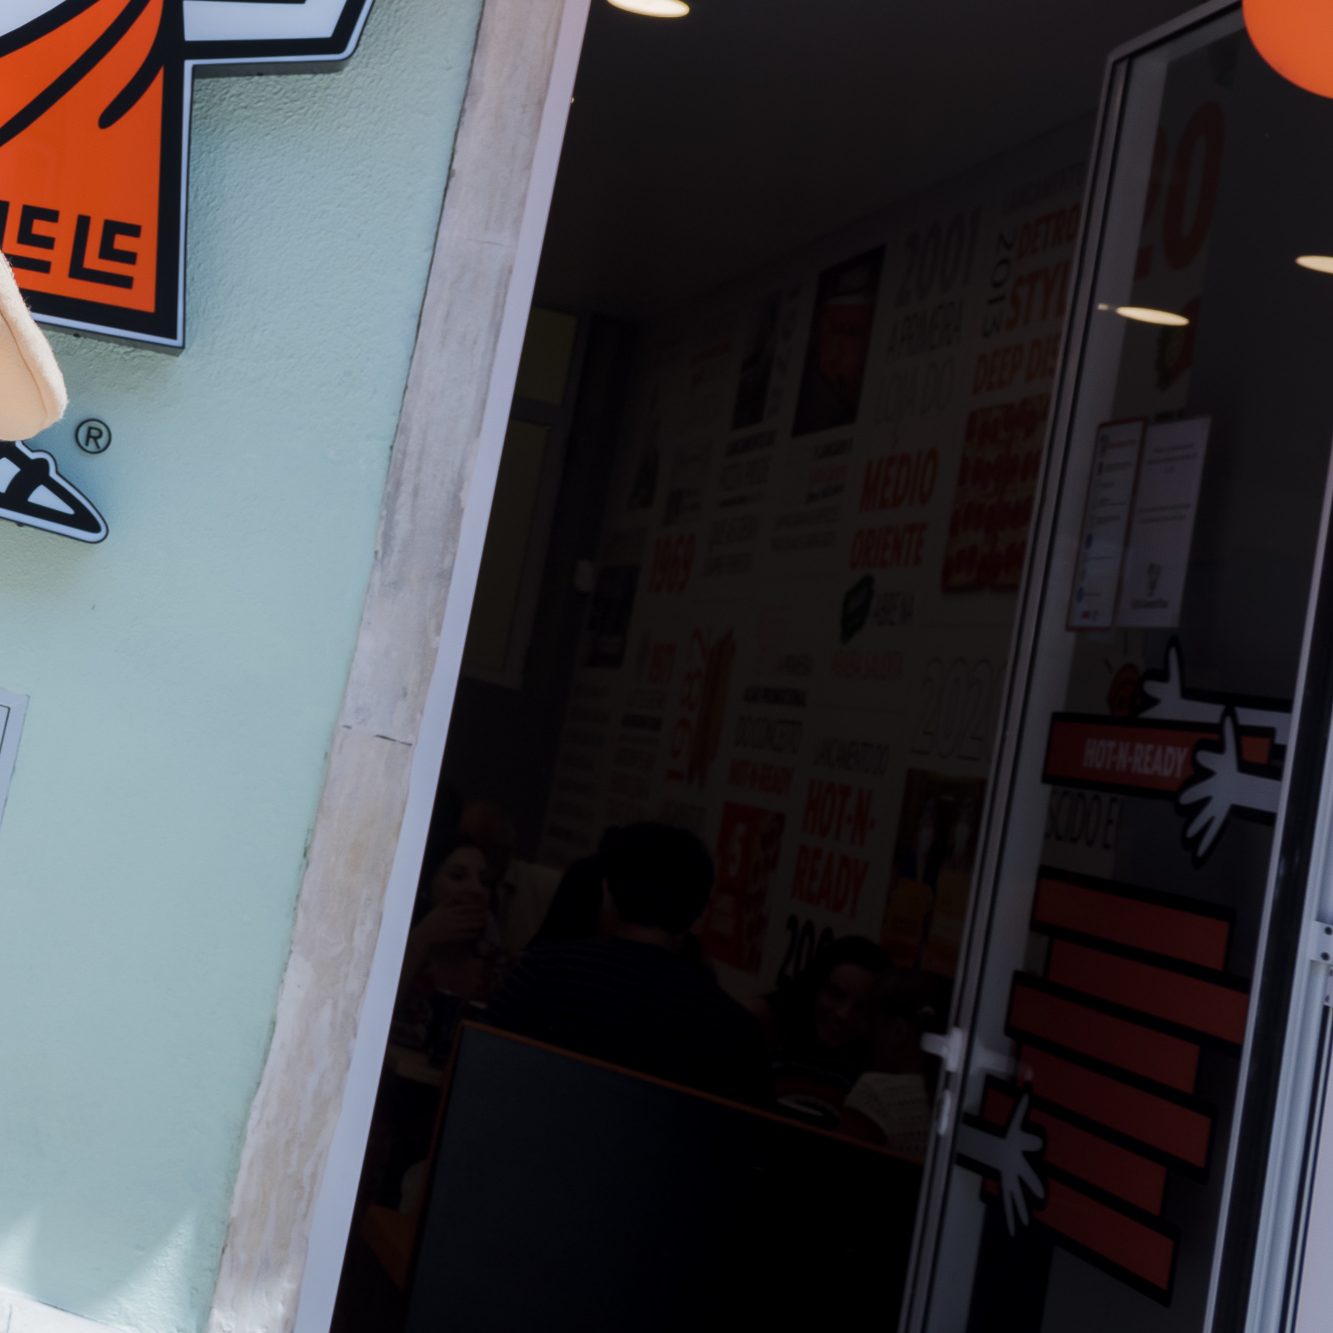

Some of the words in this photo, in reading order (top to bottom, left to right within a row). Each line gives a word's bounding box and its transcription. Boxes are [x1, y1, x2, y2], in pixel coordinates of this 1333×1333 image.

[849, 522, 929, 571] ORIENTE
[1082, 736, 1189, 778] HOT-N-READY
[790, 843, 870, 920] READY
